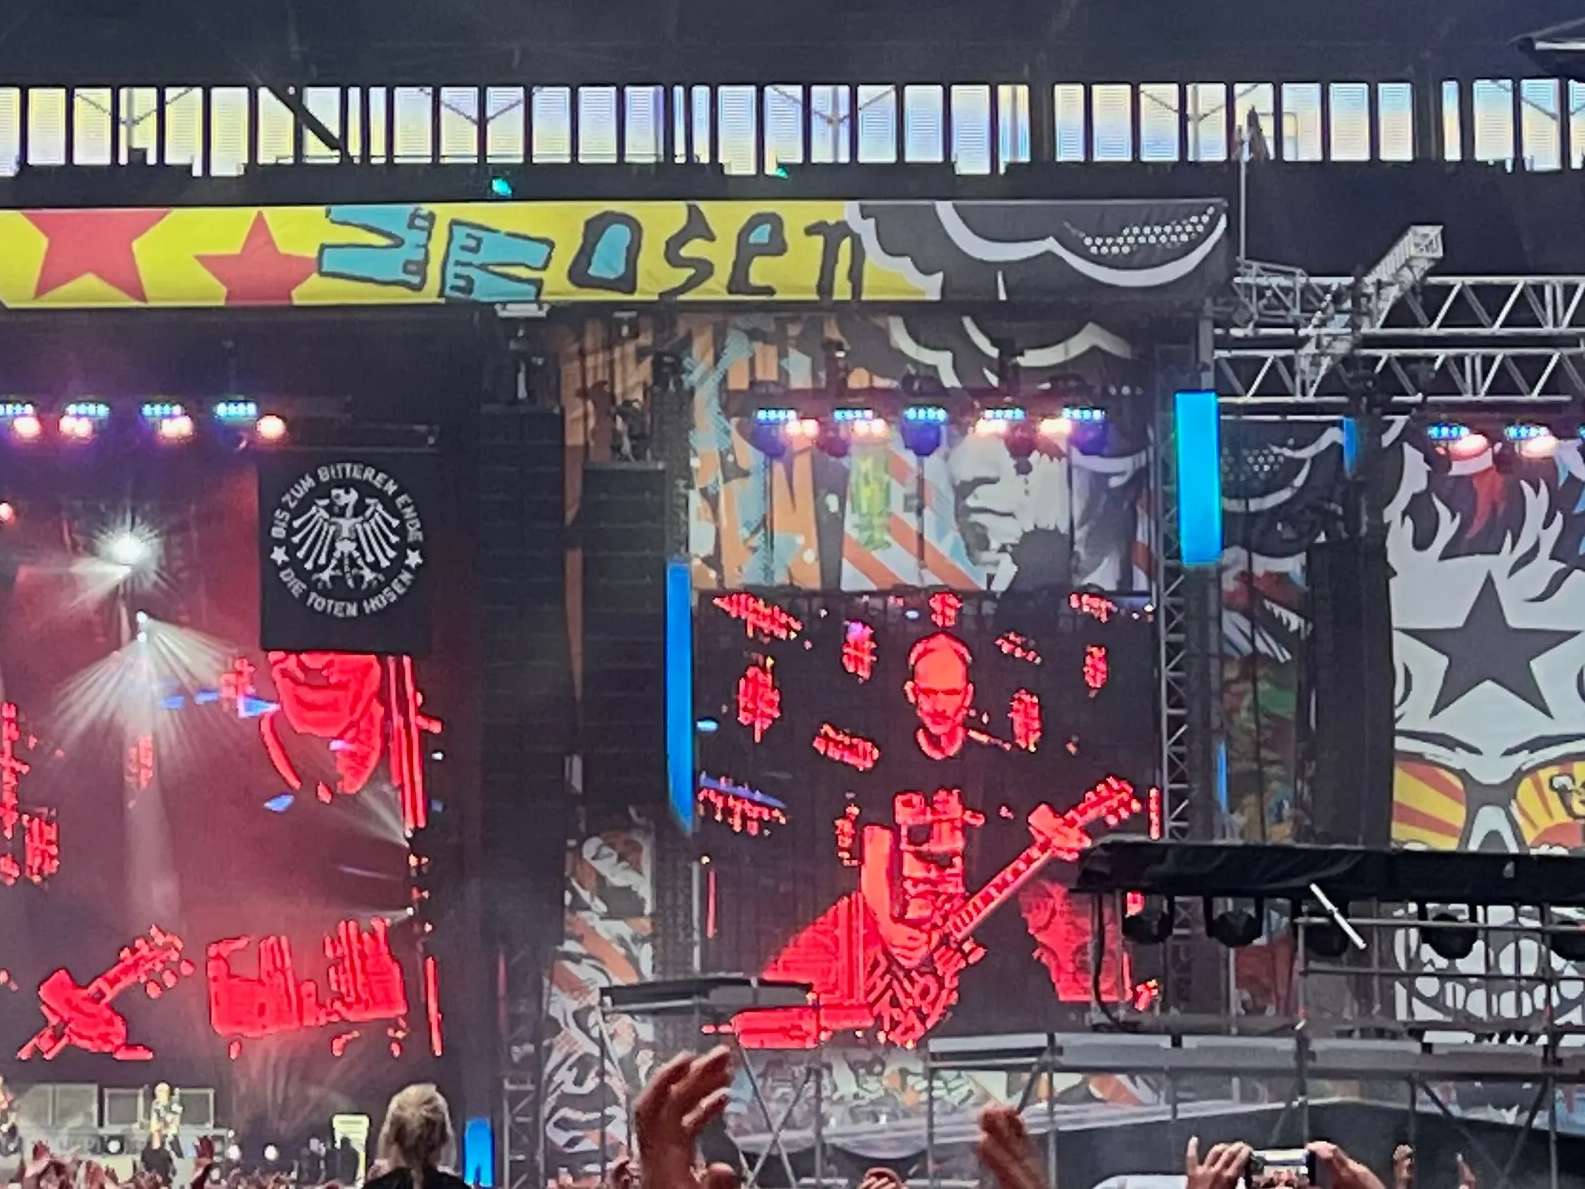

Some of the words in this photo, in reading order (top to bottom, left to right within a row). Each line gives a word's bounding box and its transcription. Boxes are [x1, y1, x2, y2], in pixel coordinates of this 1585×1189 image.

[270, 508, 291, 539] BIS
[281, 473, 316, 509] ZUM
[317, 463, 399, 496] BITTEREN
[395, 494, 423, 542] ENDE
[278, 568, 307, 599] DIE
[305, 591, 358, 618] TOTEN
[363, 571, 414, 615] HOSEN
